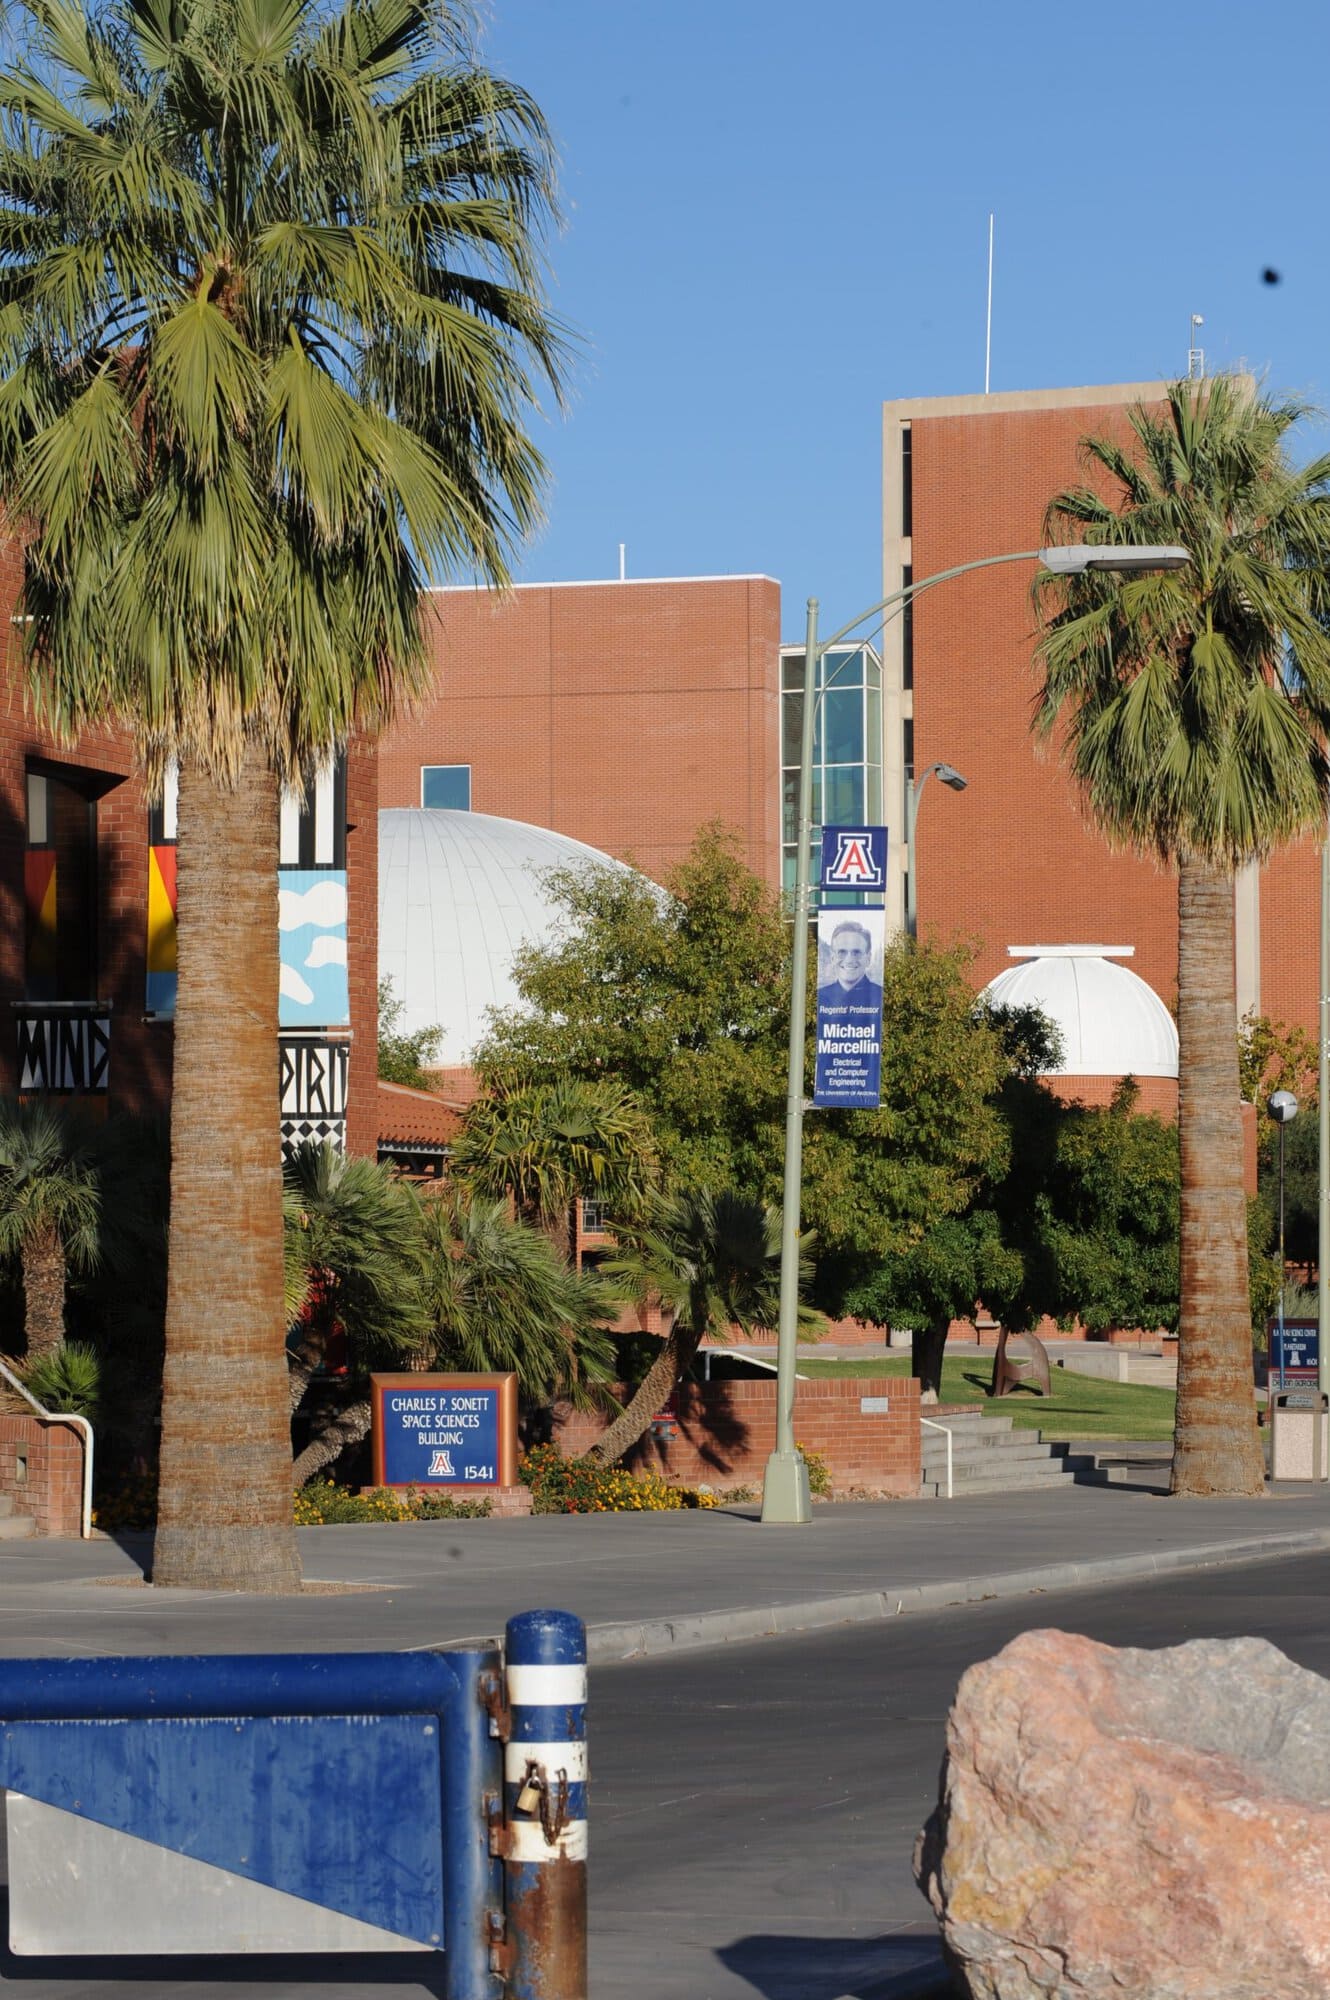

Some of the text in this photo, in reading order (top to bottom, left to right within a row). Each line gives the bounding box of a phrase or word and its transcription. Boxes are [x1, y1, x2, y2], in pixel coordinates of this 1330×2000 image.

[826, 833, 881, 885] A
[849, 1005, 879, 1014] Professor
[823, 1023, 875, 1038] Michael
[818, 1039, 880, 1054] Marcellin
[17, 1020, 110, 1088] MIND
[832, 1058, 862, 1066] Electrical
[824, 1068, 868, 1077] and Computer
[280, 1047, 349, 1113] PIRIT
[828, 1078, 866, 1087] Engineering
[391, 1397, 489, 1411] CHARLES P. SONETT
[402, 1415, 480, 1428] SPACE SCIENCES
[418, 1432, 464, 1445] BUILDING
[428, 1450, 456, 1476] A
[464, 1466, 493, 1479] 1541
